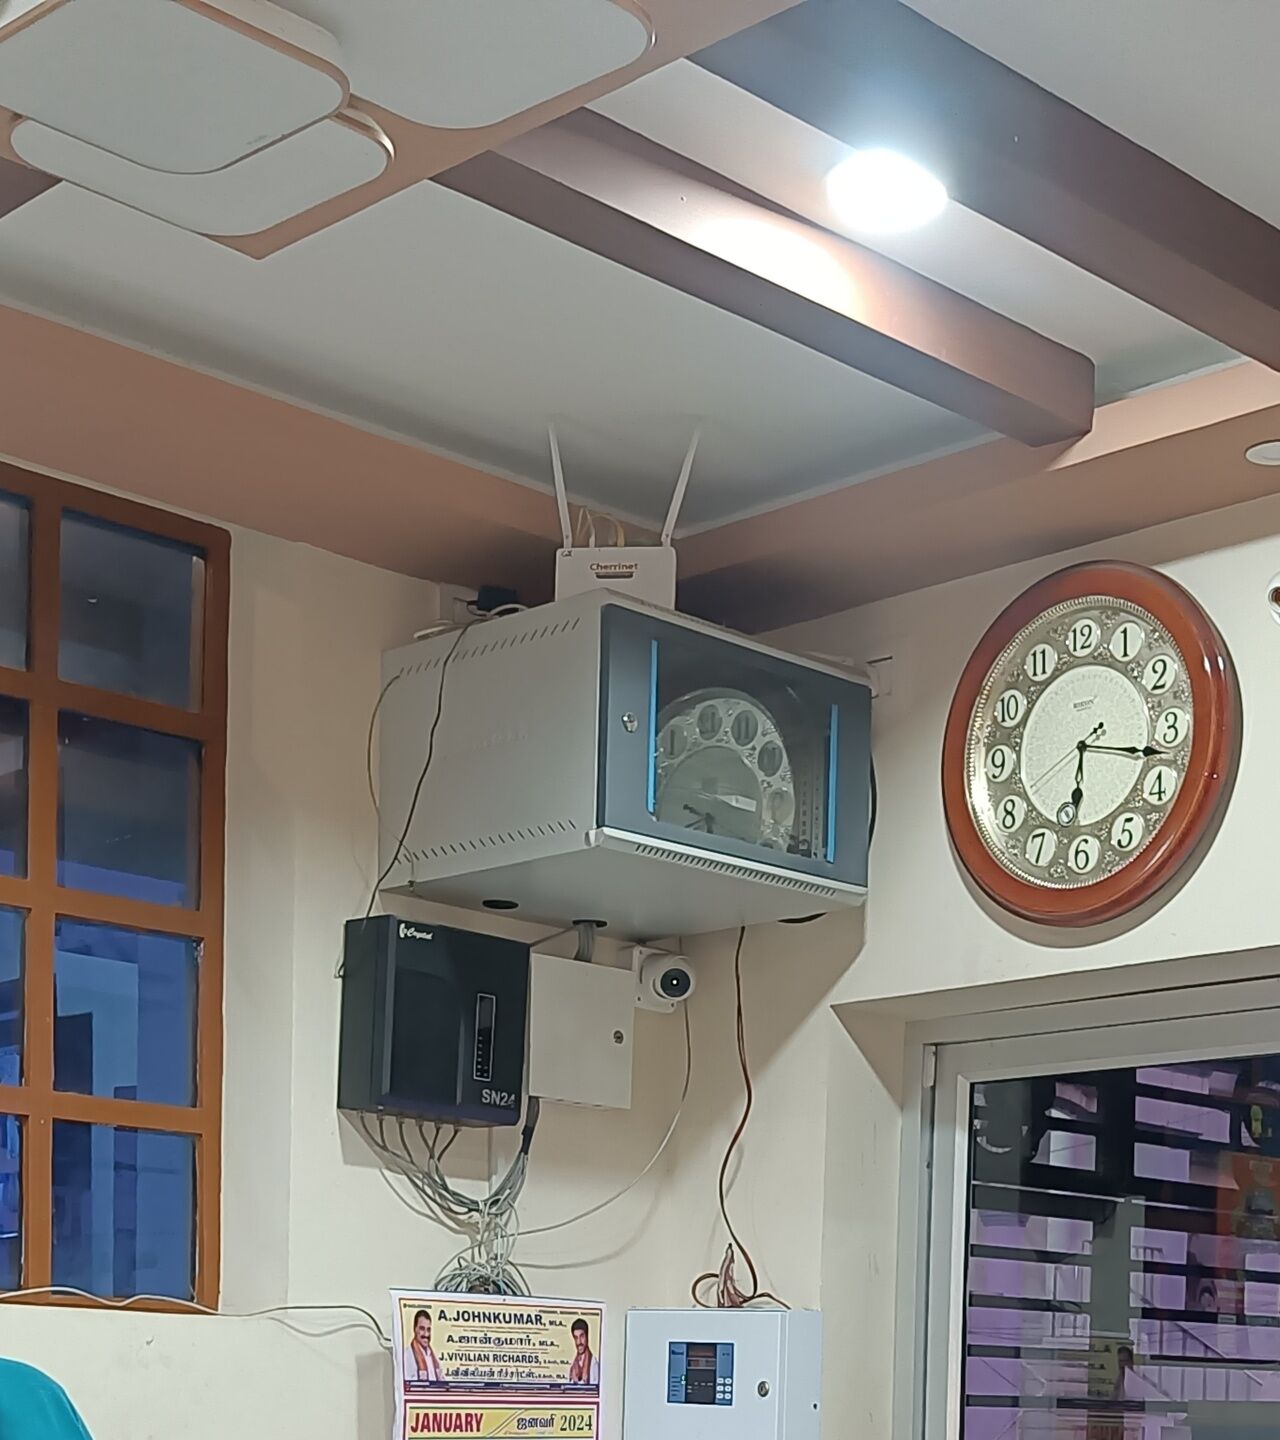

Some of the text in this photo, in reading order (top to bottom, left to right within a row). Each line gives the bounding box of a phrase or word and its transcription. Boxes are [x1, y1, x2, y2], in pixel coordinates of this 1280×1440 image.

[589, 563, 638, 571] Cherrinet
[1071, 624, 1094, 652] 12
[1120, 627, 1131, 658] 1
[1030, 648, 1048, 677] 11
[1150, 658, 1168, 692] 2
[998, 693, 1019, 723] 10
[1162, 710, 1180, 744] 3
[991, 749, 1007, 779] 9
[1147, 770, 1167, 802] 4
[1001, 799, 1015, 829] 8
[1031, 831, 1047, 864] 7
[1116, 817, 1134, 848] 5
[1073, 838, 1091, 871] 6
[438, 1309, 546, 1328] A.JOHNKUMAR,
[438, 1352, 490, 1363] J.VIVILIAN
[410, 1412, 484, 1433] JANUARY
[516, 1413, 593, 1432] ஜனவரி 2024
